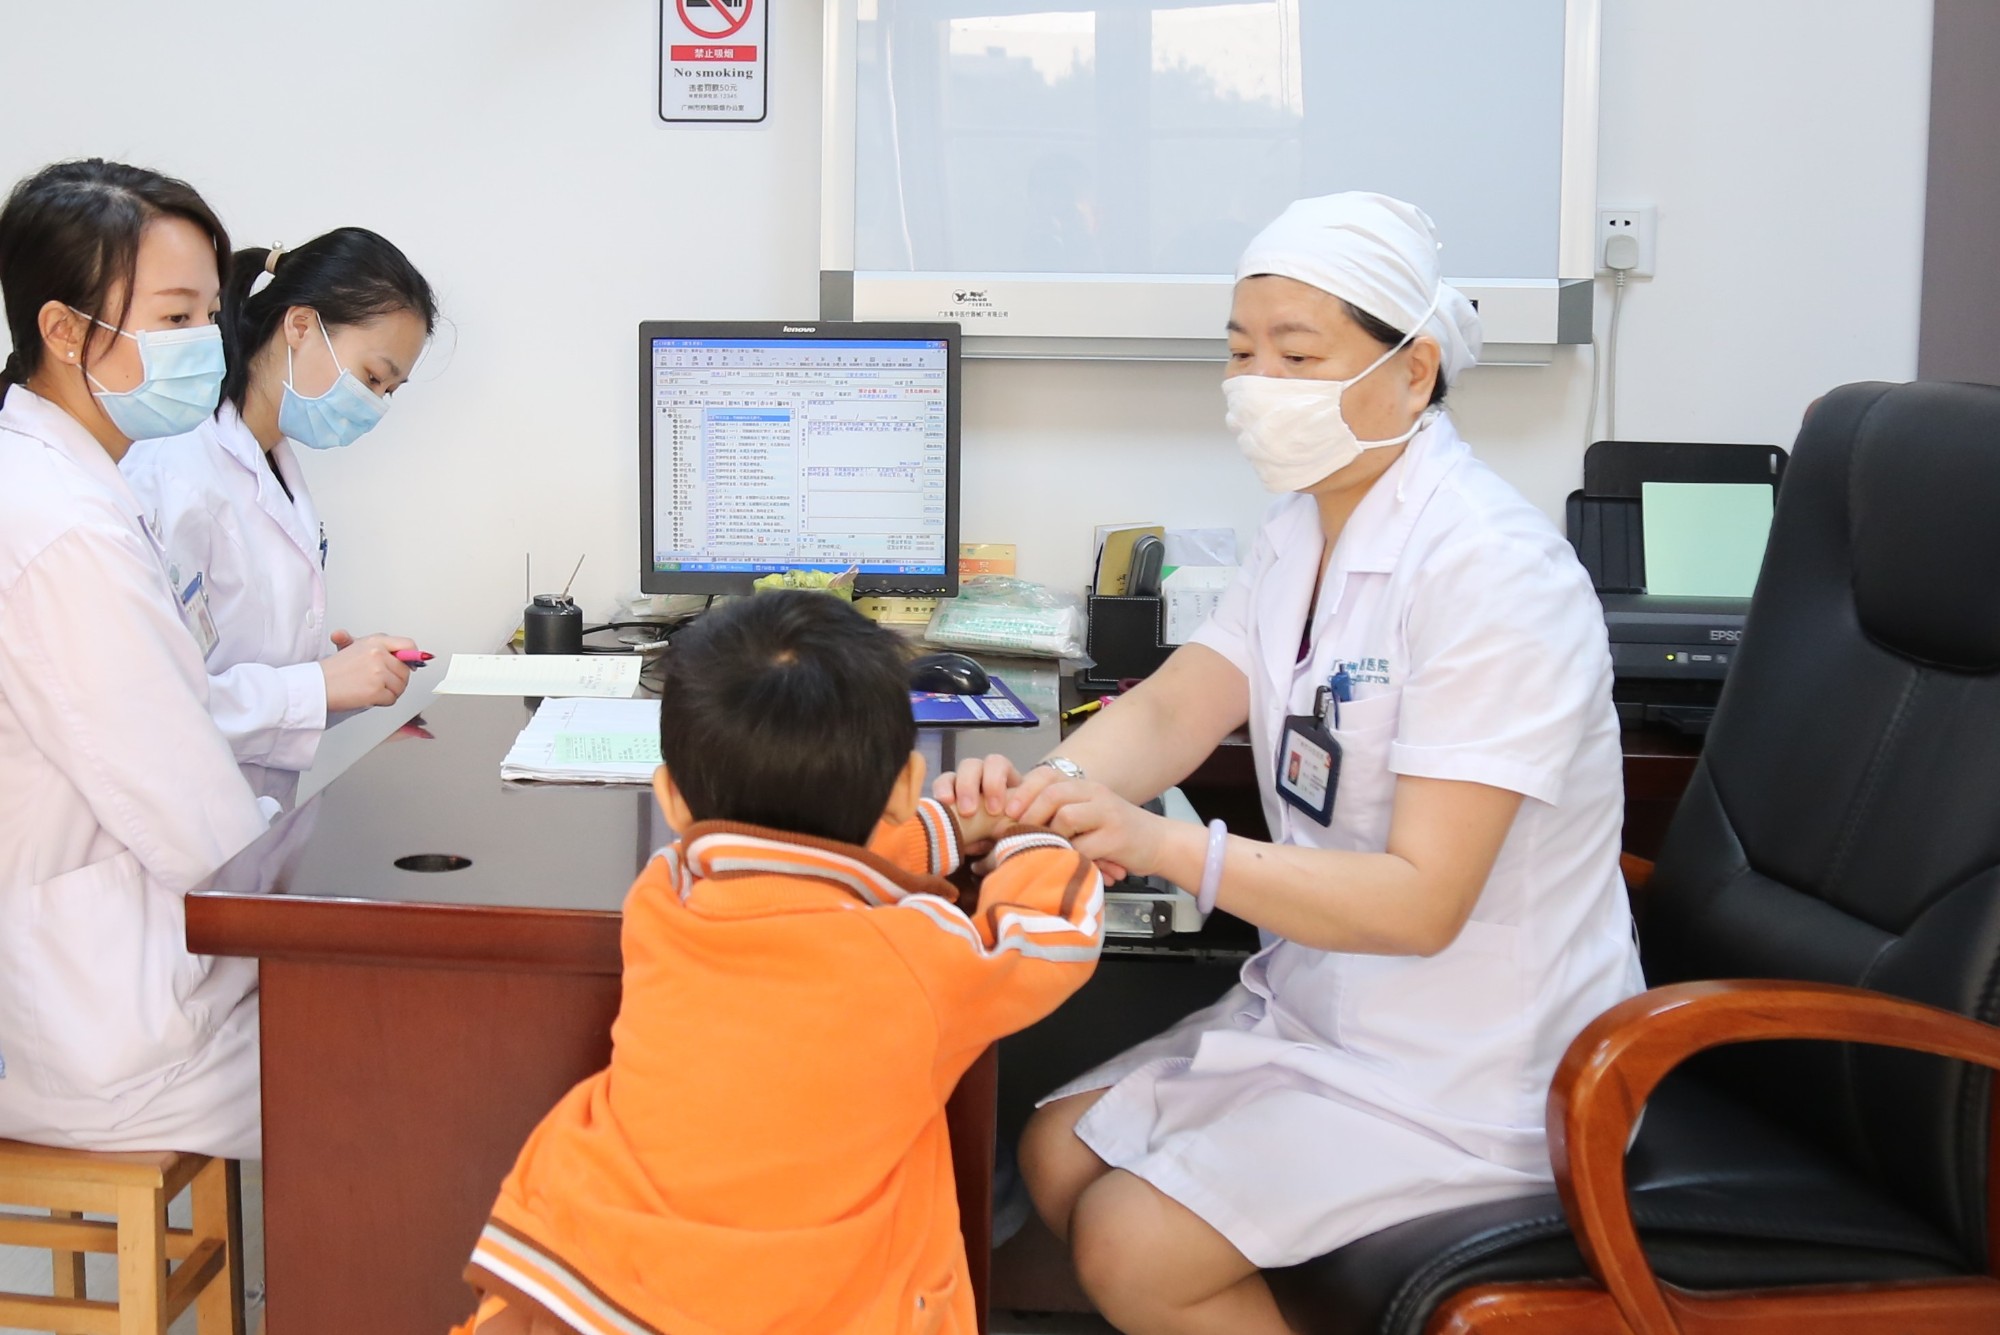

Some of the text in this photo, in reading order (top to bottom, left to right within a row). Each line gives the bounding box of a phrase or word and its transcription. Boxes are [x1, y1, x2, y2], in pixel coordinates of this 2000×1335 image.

[694, 48, 734, 59] 禁止吸烟
[673, 67, 754, 80] No smoking
[783, 325, 816, 333] lenovo
